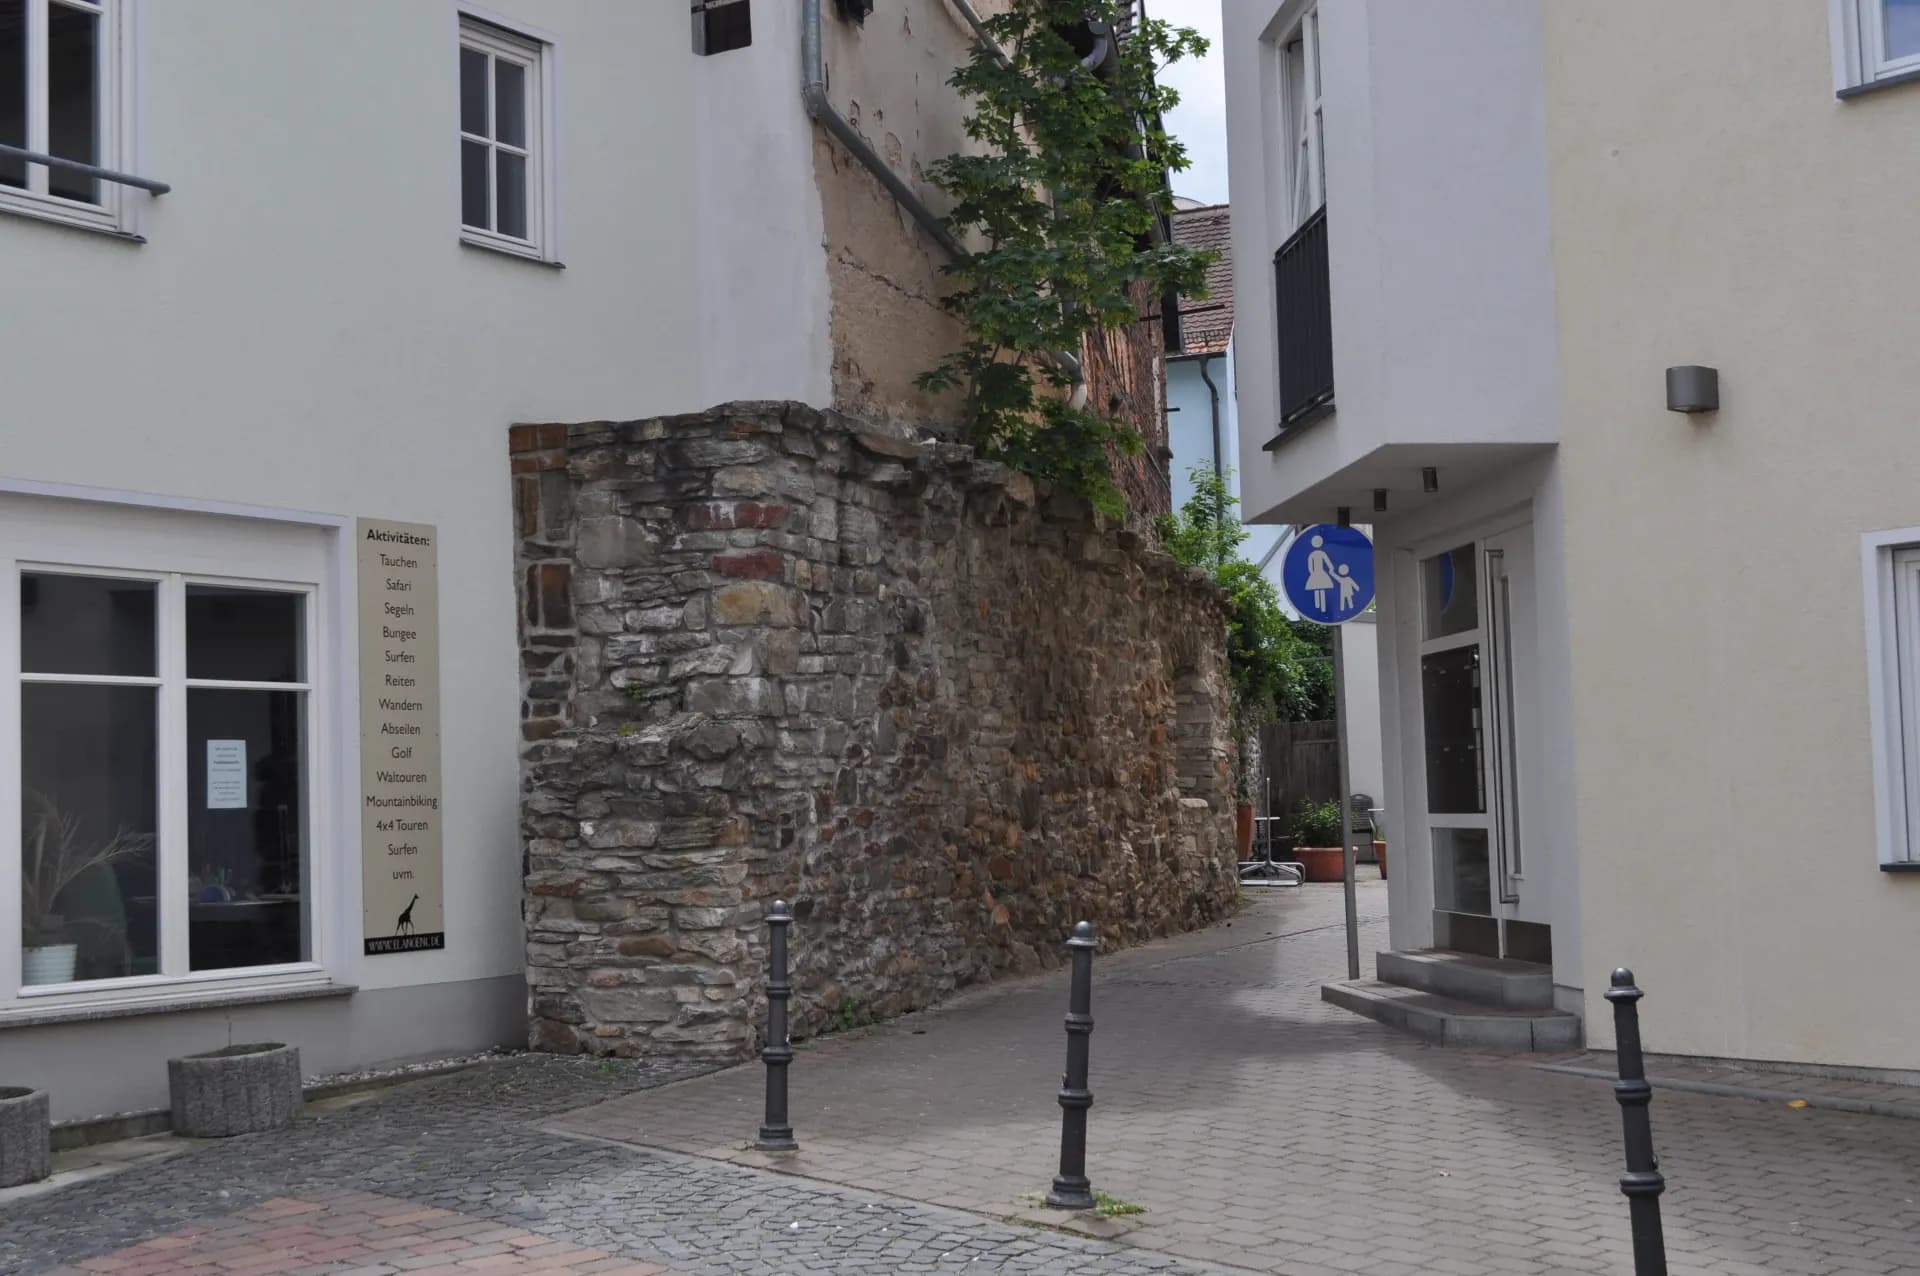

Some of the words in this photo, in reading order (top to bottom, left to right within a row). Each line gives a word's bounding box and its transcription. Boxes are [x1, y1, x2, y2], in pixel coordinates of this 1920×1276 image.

[366, 529, 430, 546] Aktivitäten:
[380, 553, 417, 568] Tauchen
[386, 578, 411, 591] Safari
[385, 602, 414, 618] Segeln
[383, 626, 416, 642] Bungee
[385, 650, 415, 664] Surfen
[385, 674, 415, 687] Reiten
[379, 699, 422, 711] Wandern
[381, 723, 420, 736] Abseilen
[392, 747, 412, 759] Golf
[376, 771, 427, 783] Waltouren
[366, 796, 438, 810] Mountainbiking
[376, 820, 393, 831] 4x4
[396, 819, 428, 831] Touren
[388, 844, 417, 856] Surfen
[393, 870, 414, 880] uvm.
